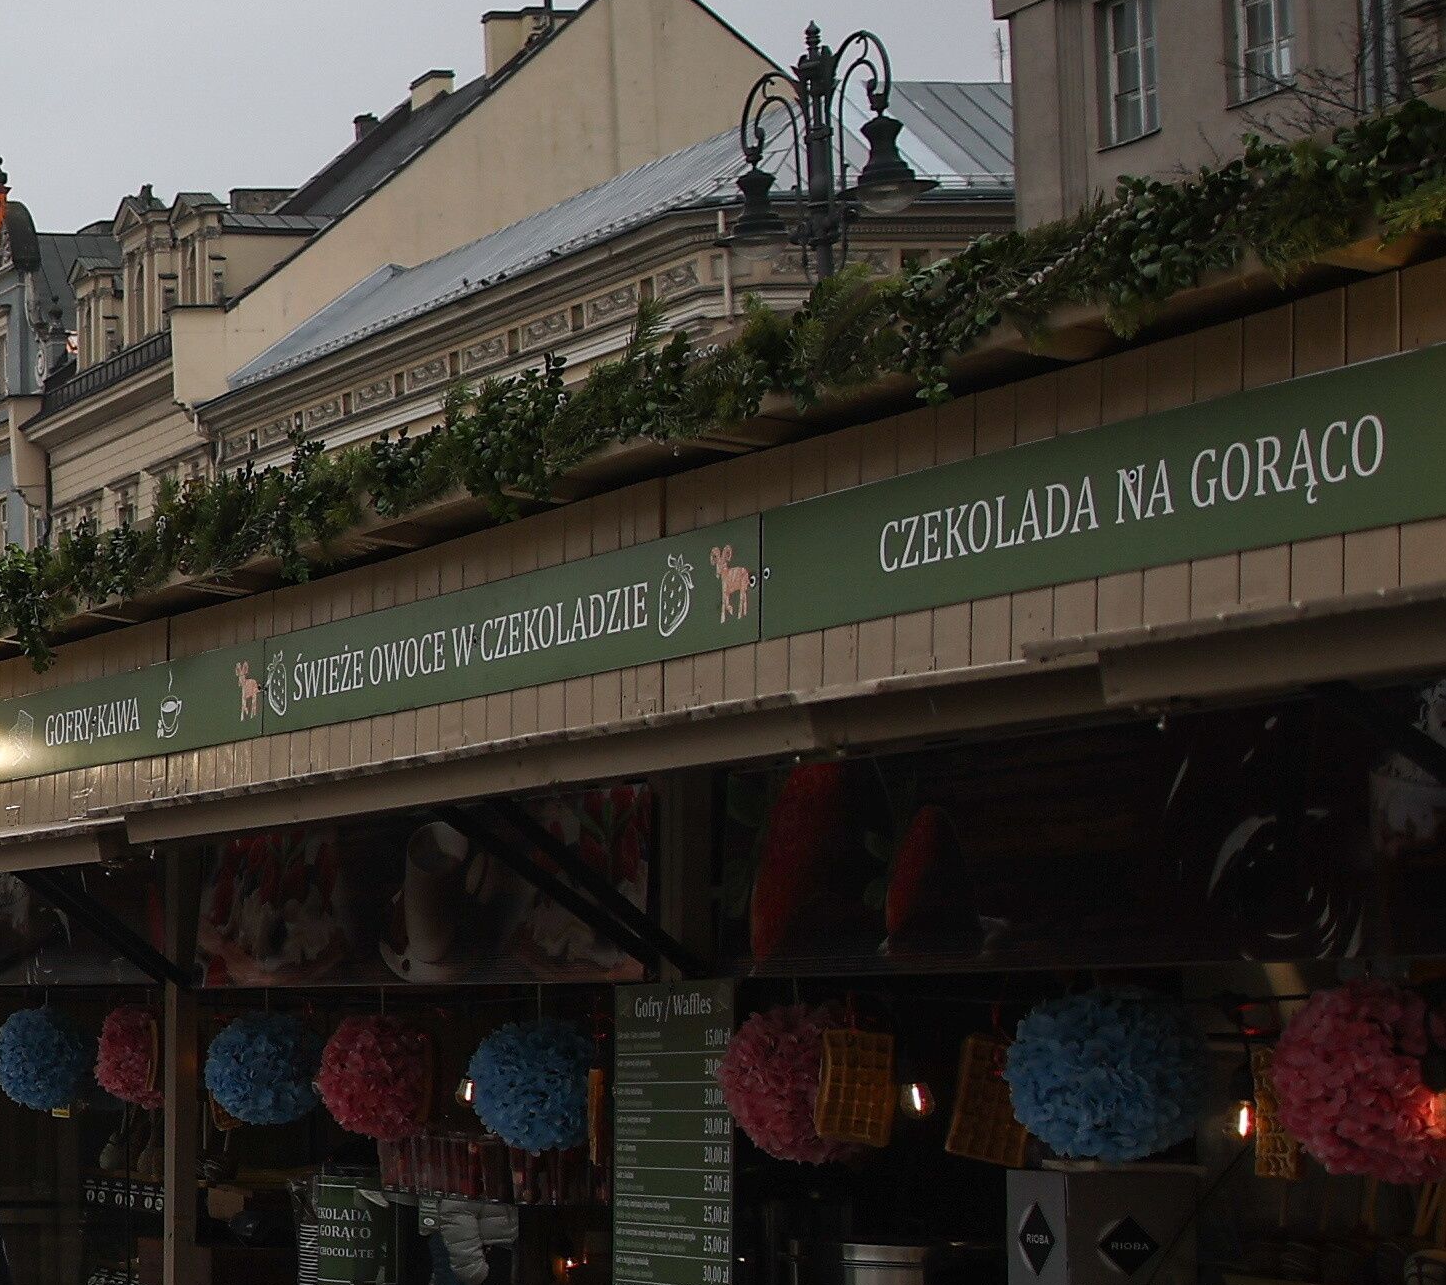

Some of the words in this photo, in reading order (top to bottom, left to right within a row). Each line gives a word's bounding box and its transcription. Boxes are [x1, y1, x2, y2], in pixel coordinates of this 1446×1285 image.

[879, 475, 1099, 573] CZEKOLADA
[1115, 458, 1175, 525] NA
[1190, 413, 1384, 509] GORĄCO
[292, 642, 365, 702] ŚWIEŻE
[369, 630, 447, 686] OWOCE
[450, 623, 476, 668] W
[479, 581, 650, 663] CZEKOLADZIE
[96, 696, 141, 738] KAWA
[635, 996, 662, 1023] Gofry
[672, 993, 712, 1016] Waffles
[318, 1207, 372, 1222] KOLADA
[1026, 1233, 1050, 1245] RIOBA
[1110, 1241, 1150, 1251] RIOBA
